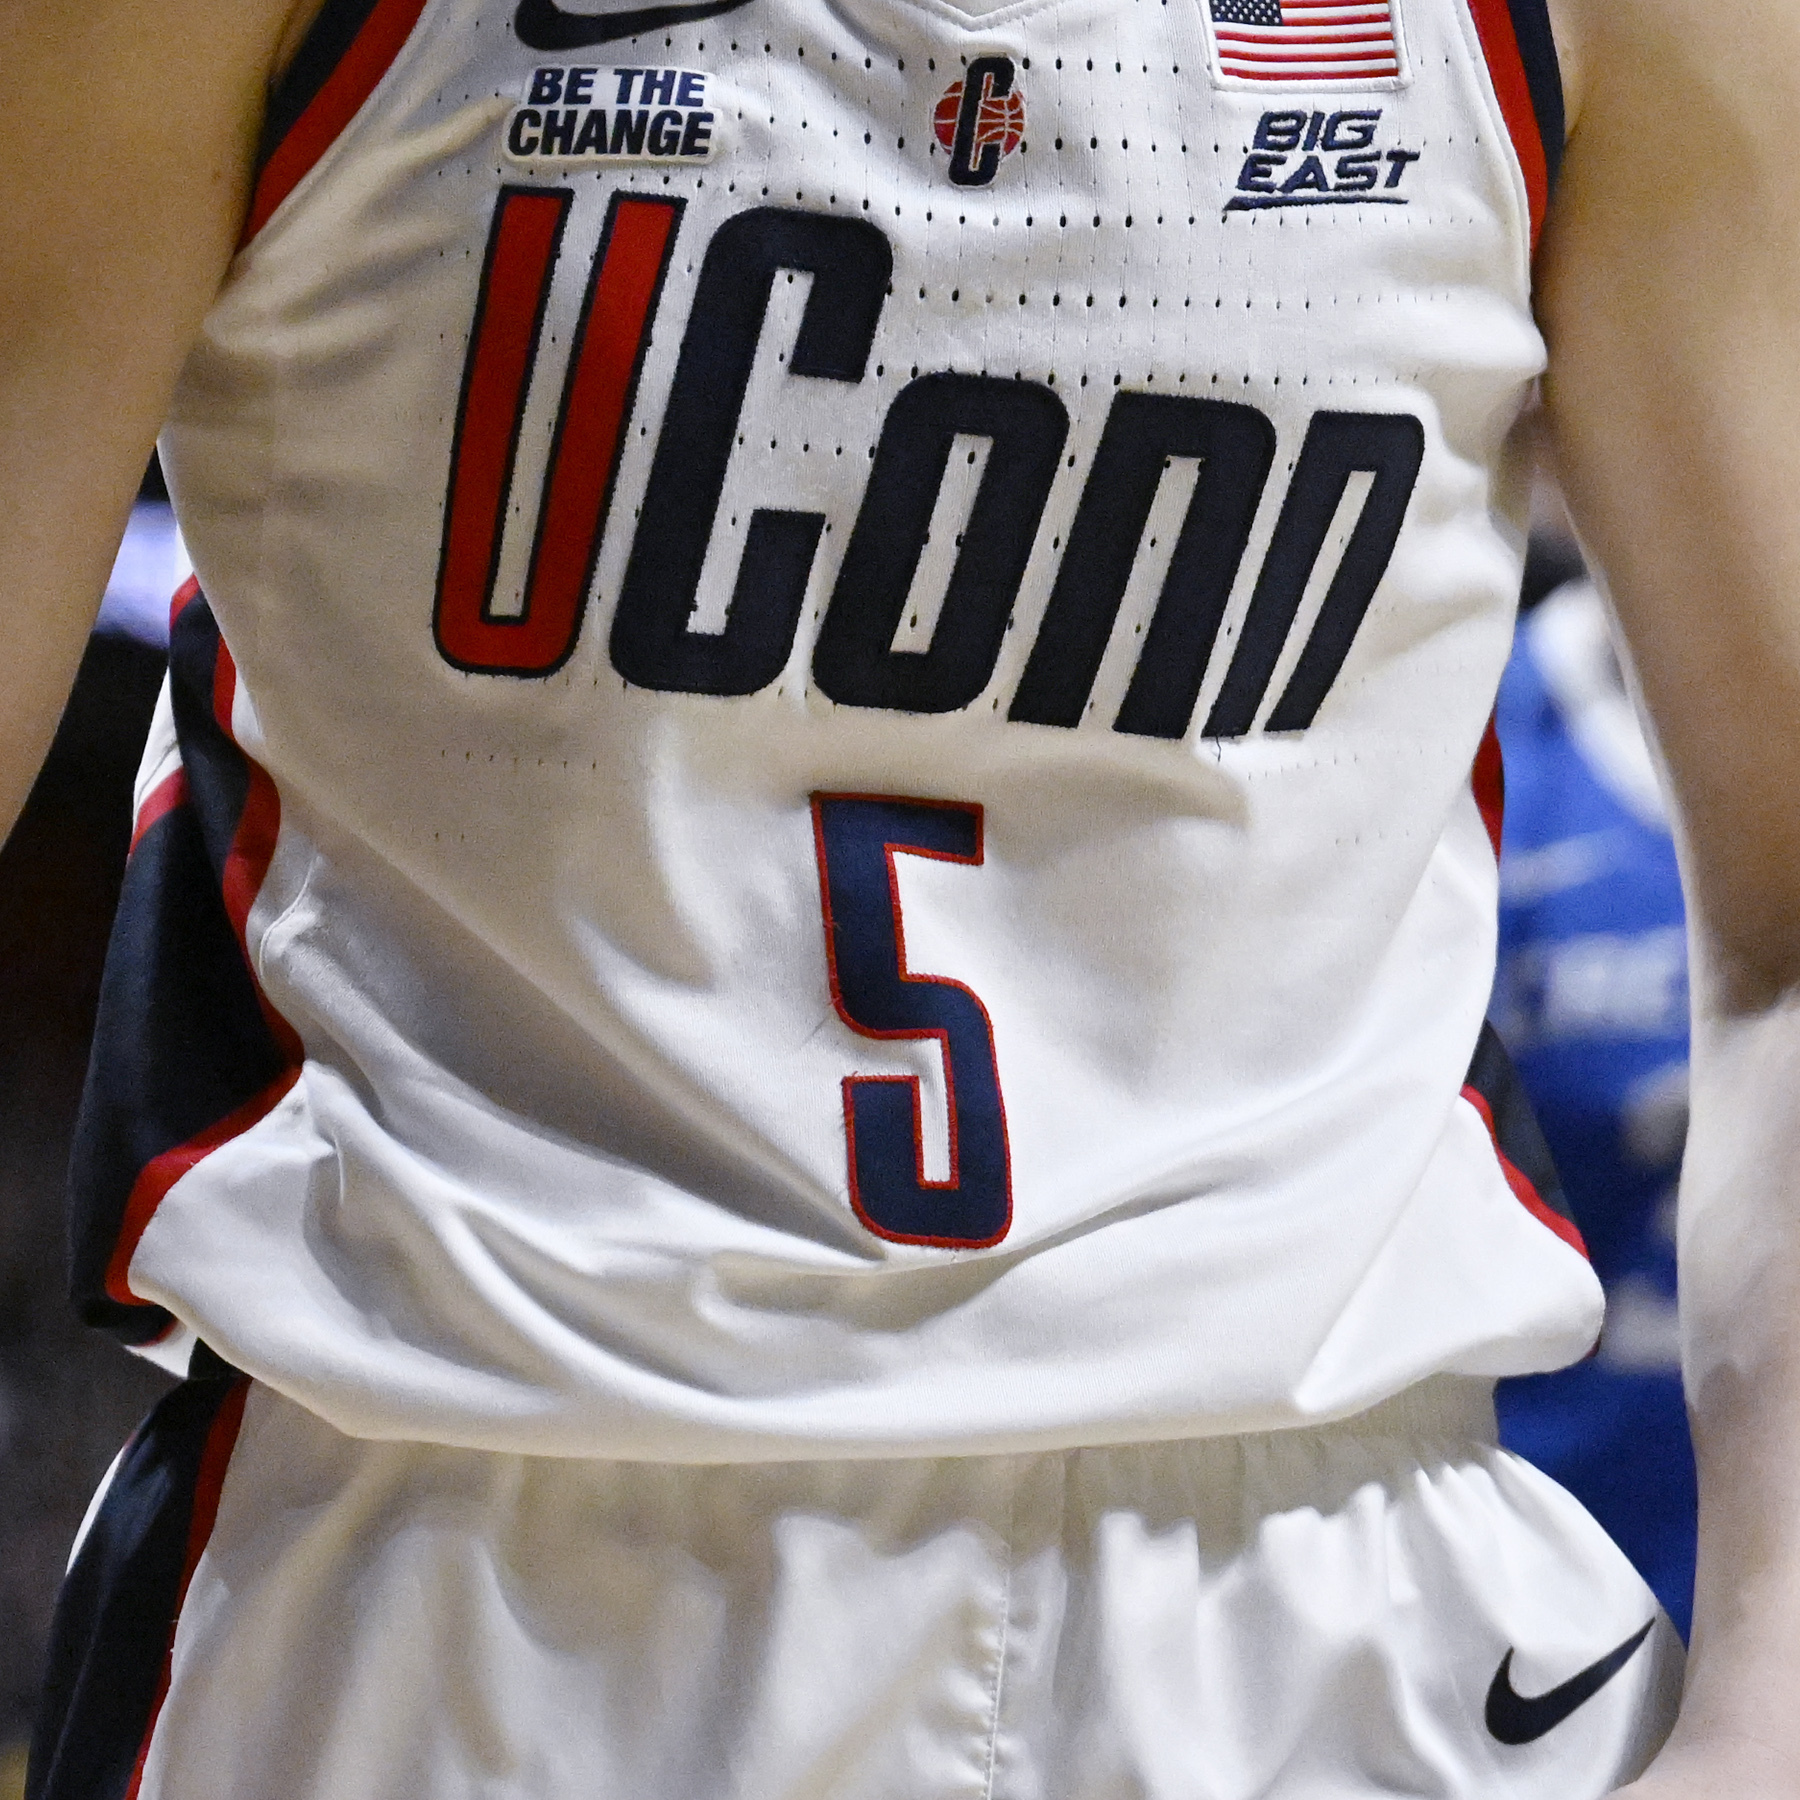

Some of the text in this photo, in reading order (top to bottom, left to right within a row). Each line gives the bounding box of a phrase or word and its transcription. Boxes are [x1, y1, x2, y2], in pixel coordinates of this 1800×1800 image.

[527, 67, 706, 108] BE THE
[507, 108, 715, 157] CHANGE
[1251, 108, 1384, 152] BIG
[1235, 150, 1421, 193] EAST
[810, 789, 1014, 1250] 5
